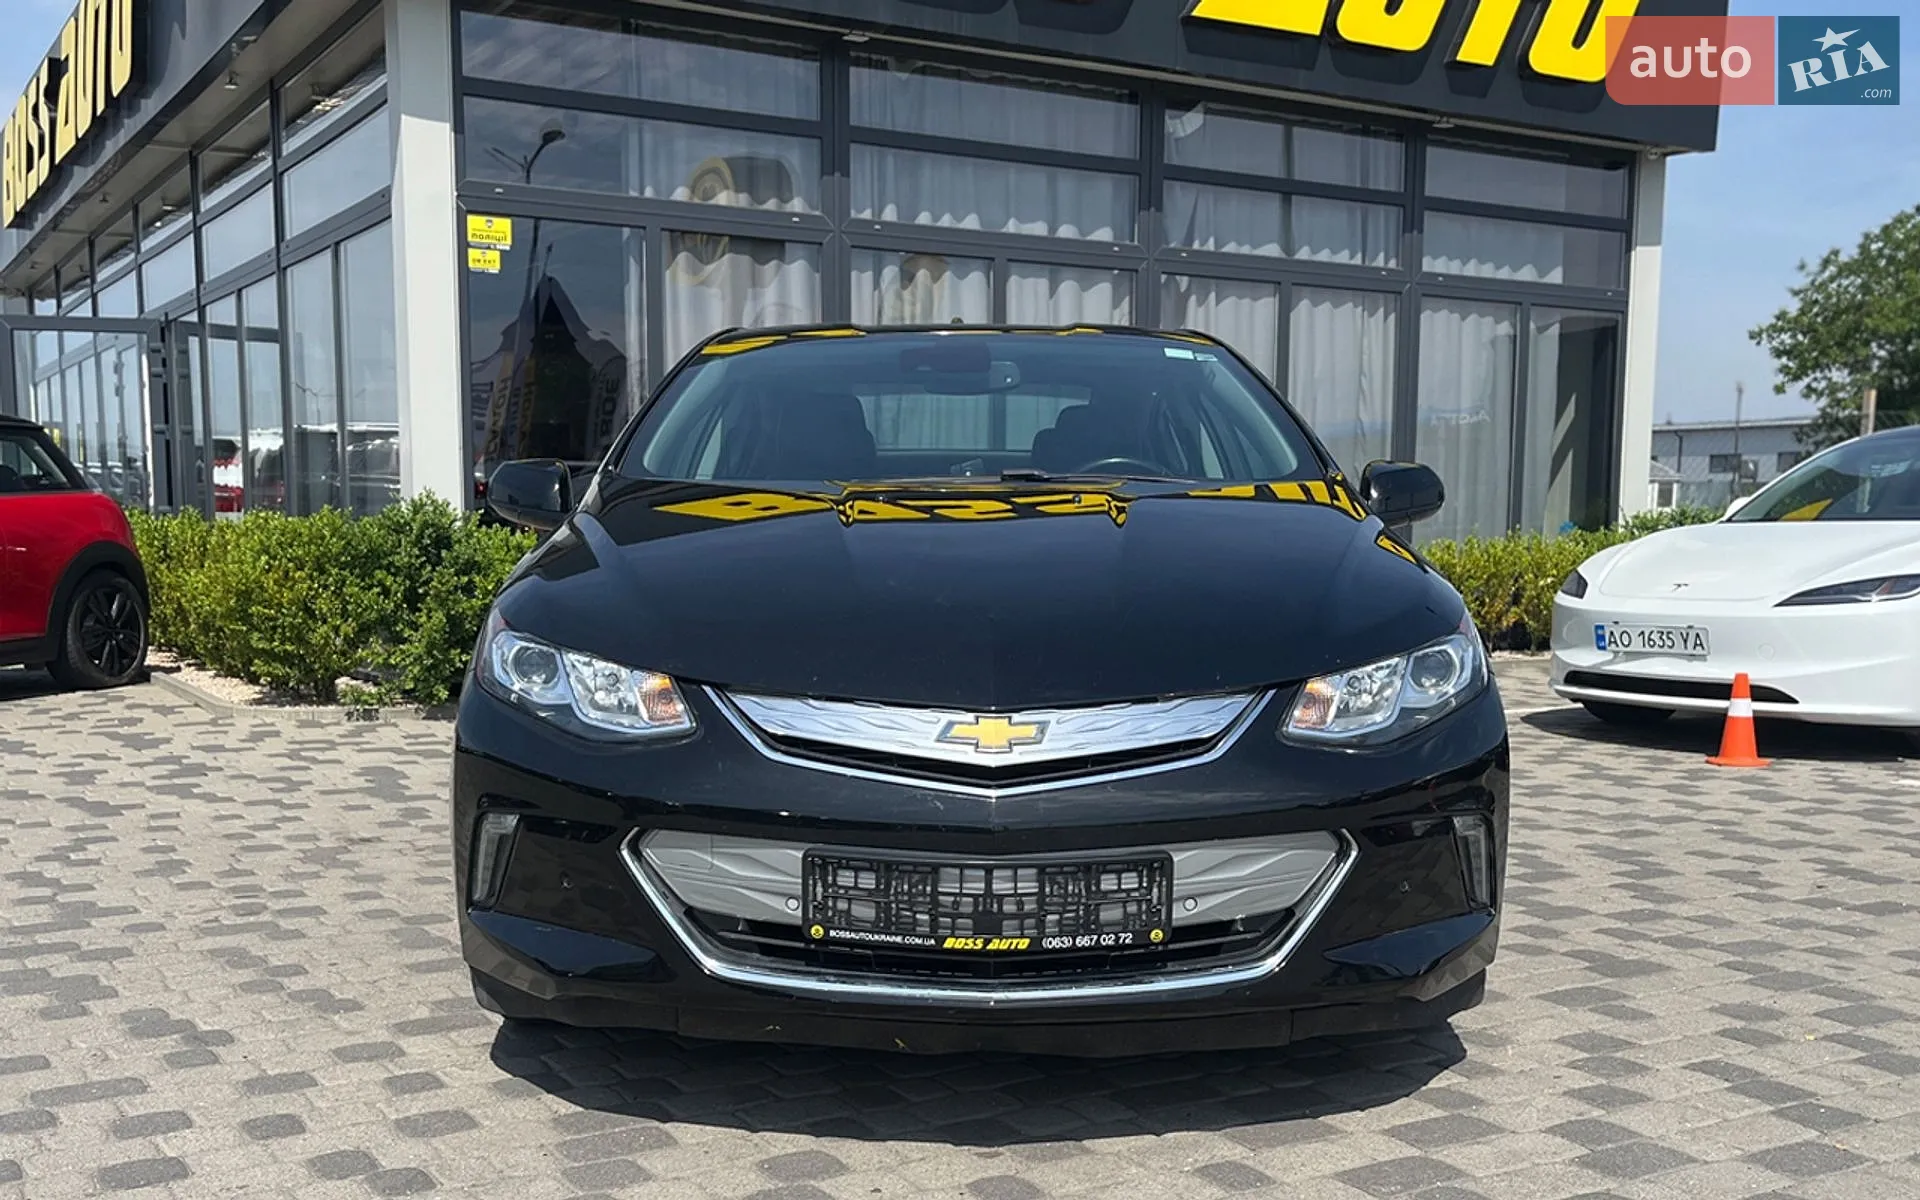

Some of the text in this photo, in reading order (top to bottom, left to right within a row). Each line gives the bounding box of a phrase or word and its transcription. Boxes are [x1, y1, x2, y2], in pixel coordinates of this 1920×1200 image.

[3, 56, 50, 228] BOSS
[1607, 630, 1705, 651] AO 1635 YA
[943, 937, 1031, 950] BOSS AUTO
[1042, 932, 1133, 949] (063) 667 02 72
